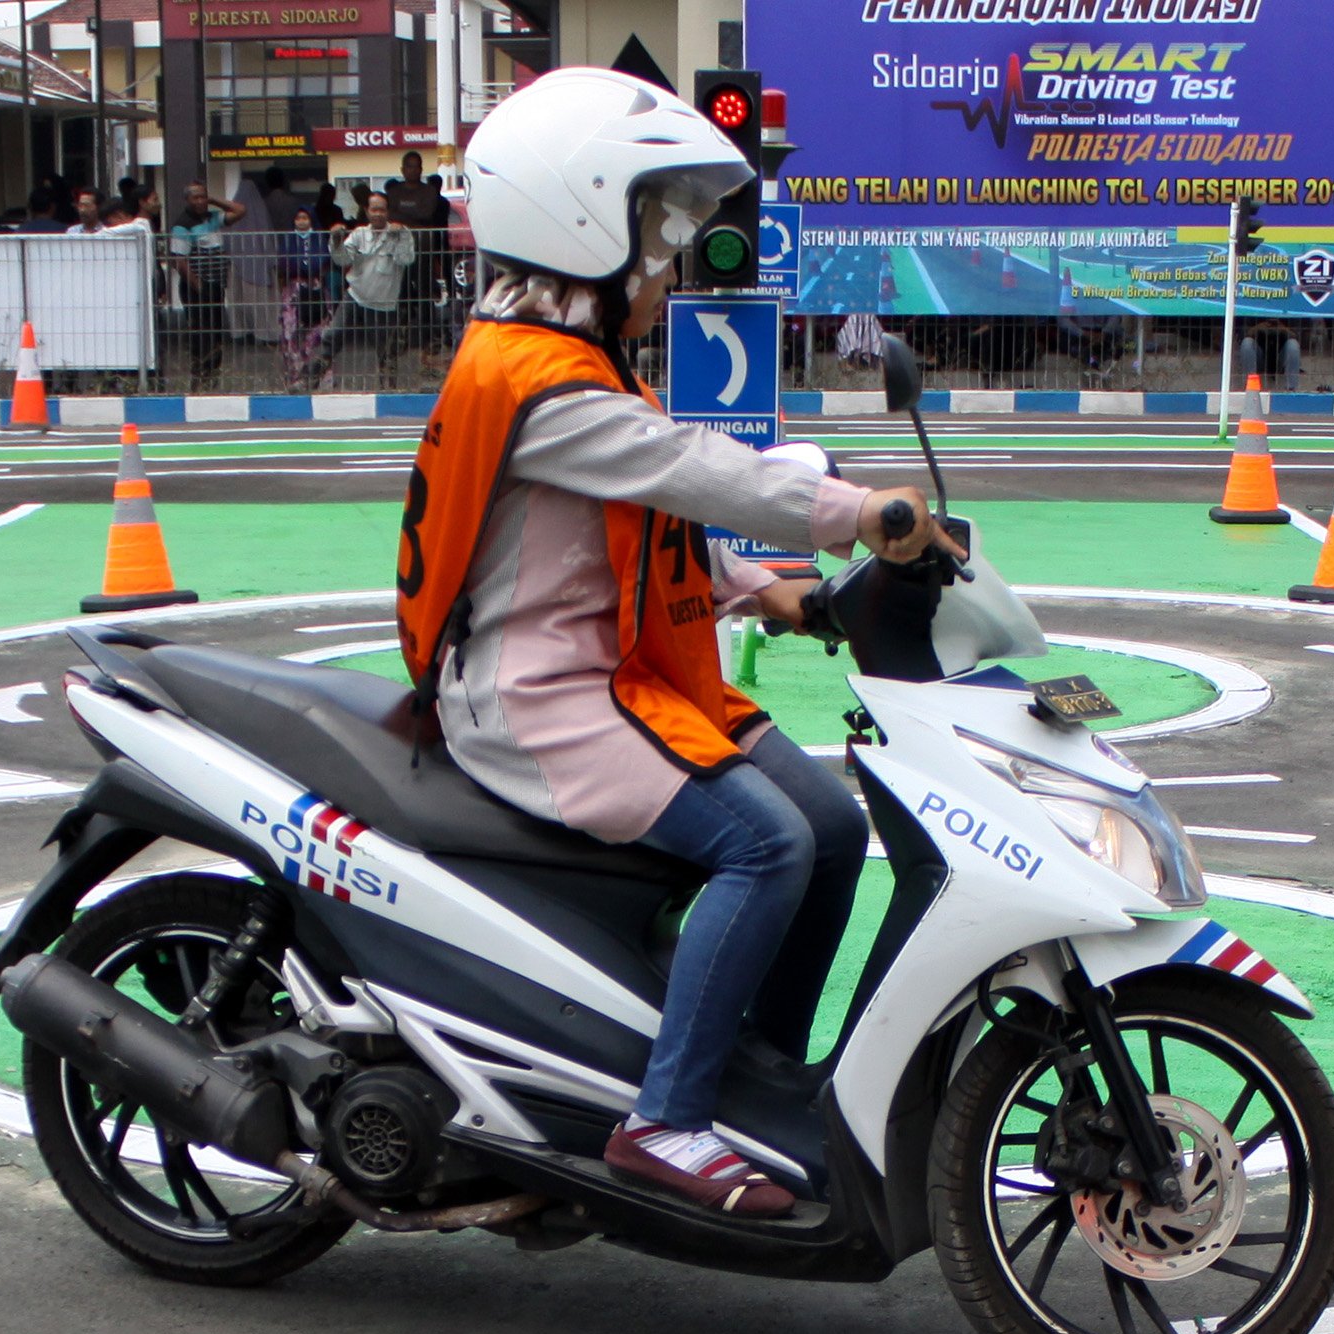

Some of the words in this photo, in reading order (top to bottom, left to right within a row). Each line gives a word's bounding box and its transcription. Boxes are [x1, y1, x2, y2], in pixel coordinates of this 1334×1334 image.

[189, 11, 271, 26] POLRESTA
[280, 8, 359, 25] SIDOARJO
[872, 53, 999, 95] Sidoarjo
[1022, 42, 1246, 72] SMART
[1038, 75, 1157, 104] Driving
[1171, 75, 1236, 100] Test
[1014, 114, 1059, 126] Vibration
[1061, 114, 1096, 126] Sensor
[1098, 114, 1105, 126] &
[1107, 114, 1131, 126] Load
[1132, 114, 1151, 126] Cell
[1153, 114, 1188, 126] Sensor
[1190, 114, 1240, 128] Tehnology
[246, 137, 270, 147] ANDA
[344, 131, 395, 147] SKCK
[1027, 134, 1156, 166] POLRESTA
[1156, 134, 1293, 166] SIDOARJO
[785, 177, 849, 203] YANG
[855, 177, 930, 203] TELAH
[934, 177, 959, 203] DI
[966, 177, 1096, 204] LAUNCHING
[1104, 177, 1150, 204] TGL
[1155, 177, 1169, 203] 4
[1175, 177, 1299, 205] DESEMBER
[802, 231, 834, 246] STEM
[838, 231, 858, 246] UJI
[863, 231, 917, 246] PRAKTEK
[921, 231, 945, 246] SIM
[948, 231, 980, 247] YANG
[985, 232, 1066, 247] TRANSPARAN
[1070, 232, 1094, 247] DAN
[1099, 232, 1169, 247] AKUNTABEL
[1208, 251, 1228, 264] Zon
[1238, 253, 1288, 267] ntegritas
[1131, 268, 1171, 281] Wilayah
[1175, 268, 1207, 281] Bebas
[1210, 268, 1252, 282] Korpsi
[1255, 268, 1288, 281] (WBK)
[1303, 260, 1330, 277] ZI
[758, 275, 783, 283] ALAN
[1082, 285, 1123, 299] Wilayah
[1127, 285, 1177, 298] Birokrasi
[1181, 285, 1216, 298] Bersih
[1219, 285, 1238, 298] dn
[1242, 286, 1287, 300] Melayani
[917, 791, 1044, 881] POLISI
[240, 800, 399, 905] POLISI
